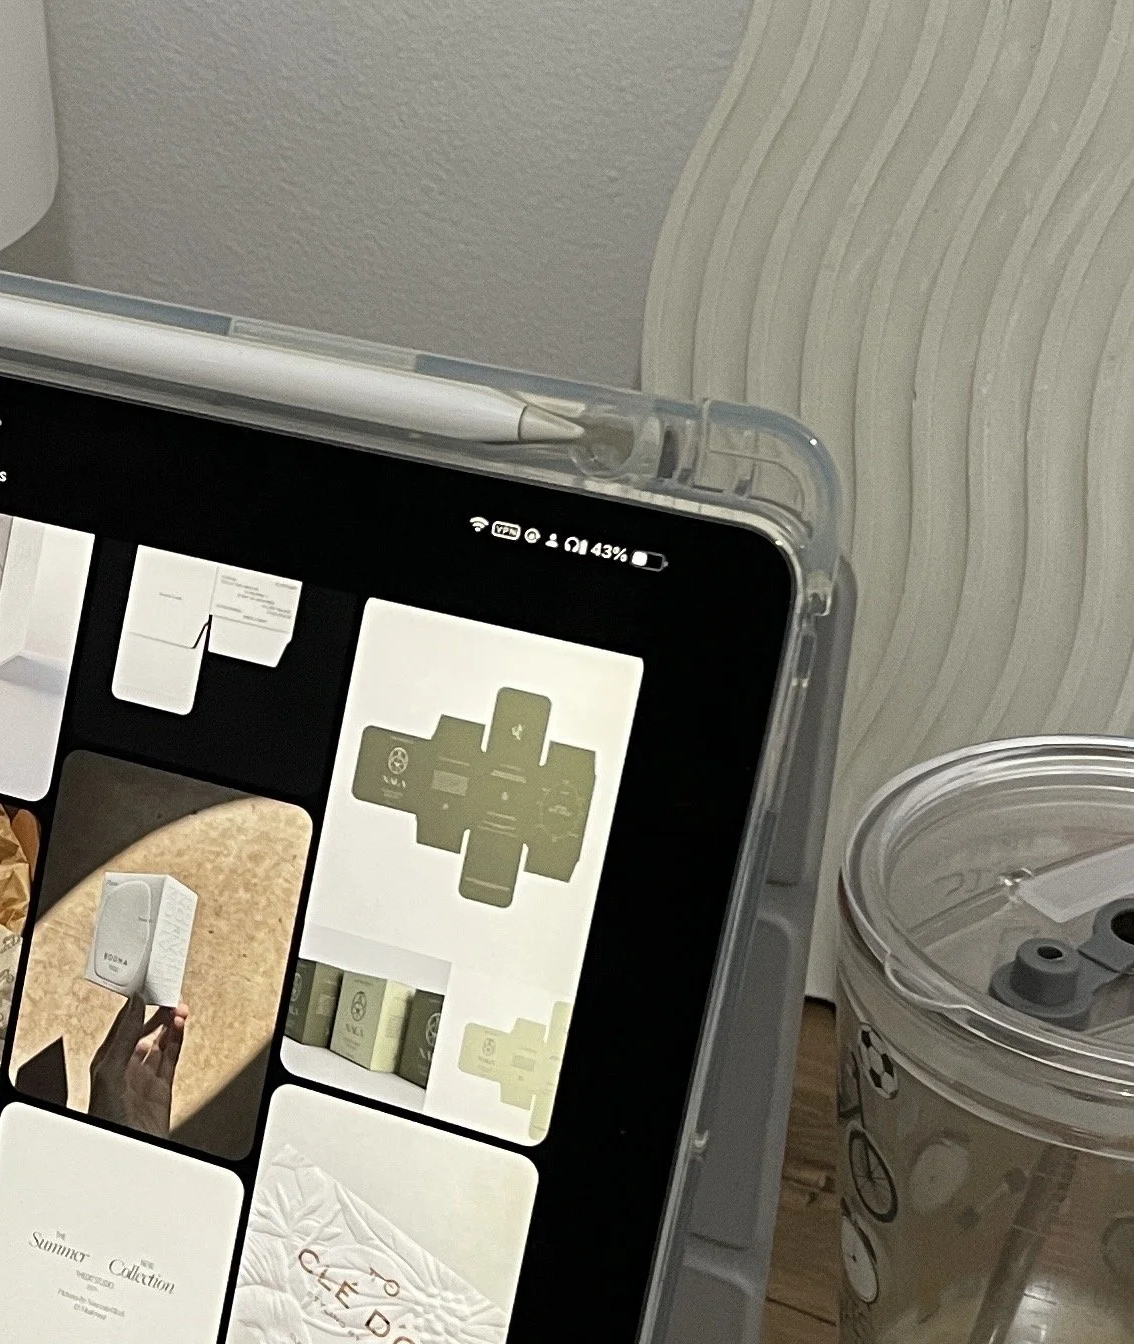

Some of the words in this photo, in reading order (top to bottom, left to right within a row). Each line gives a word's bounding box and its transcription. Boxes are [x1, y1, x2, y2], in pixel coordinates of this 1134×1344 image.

[495, 524, 518, 538] VPN
[590, 542, 628, 563] 43%
[28, 1231, 91, 1263] Summer
[108, 1258, 176, 1295] Collection
